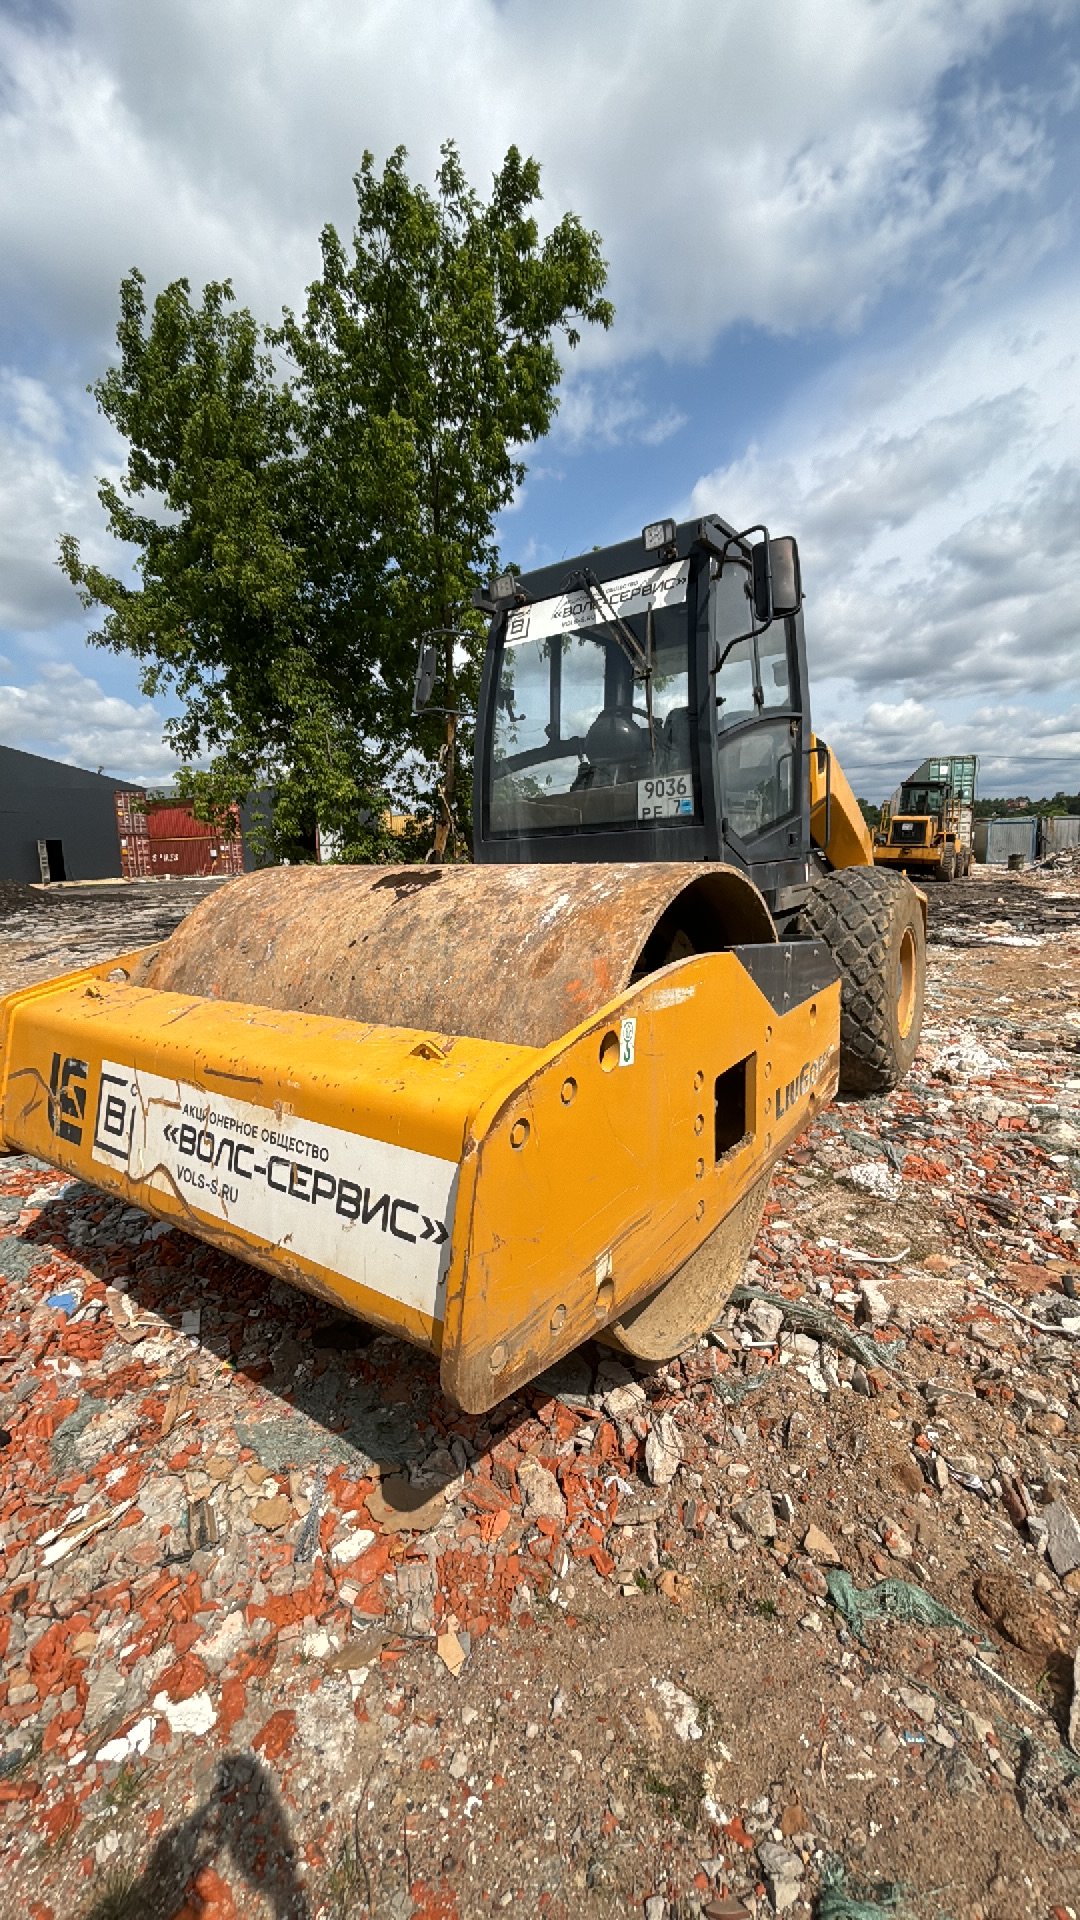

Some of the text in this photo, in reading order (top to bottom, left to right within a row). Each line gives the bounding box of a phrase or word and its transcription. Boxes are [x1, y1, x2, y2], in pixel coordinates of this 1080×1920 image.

[553, 577, 687, 619] «ВОЛ-СЕРВИС»
[644, 777, 687, 799] 9036
[181, 1103, 330, 1163] АКЦИОНЕРНОЕ ОБЩЕСТВО
[162, 1123, 450, 1246] «ВОЛС-СЕРВИС»
[176, 1164, 240, 1203] VOLS-S.RU
